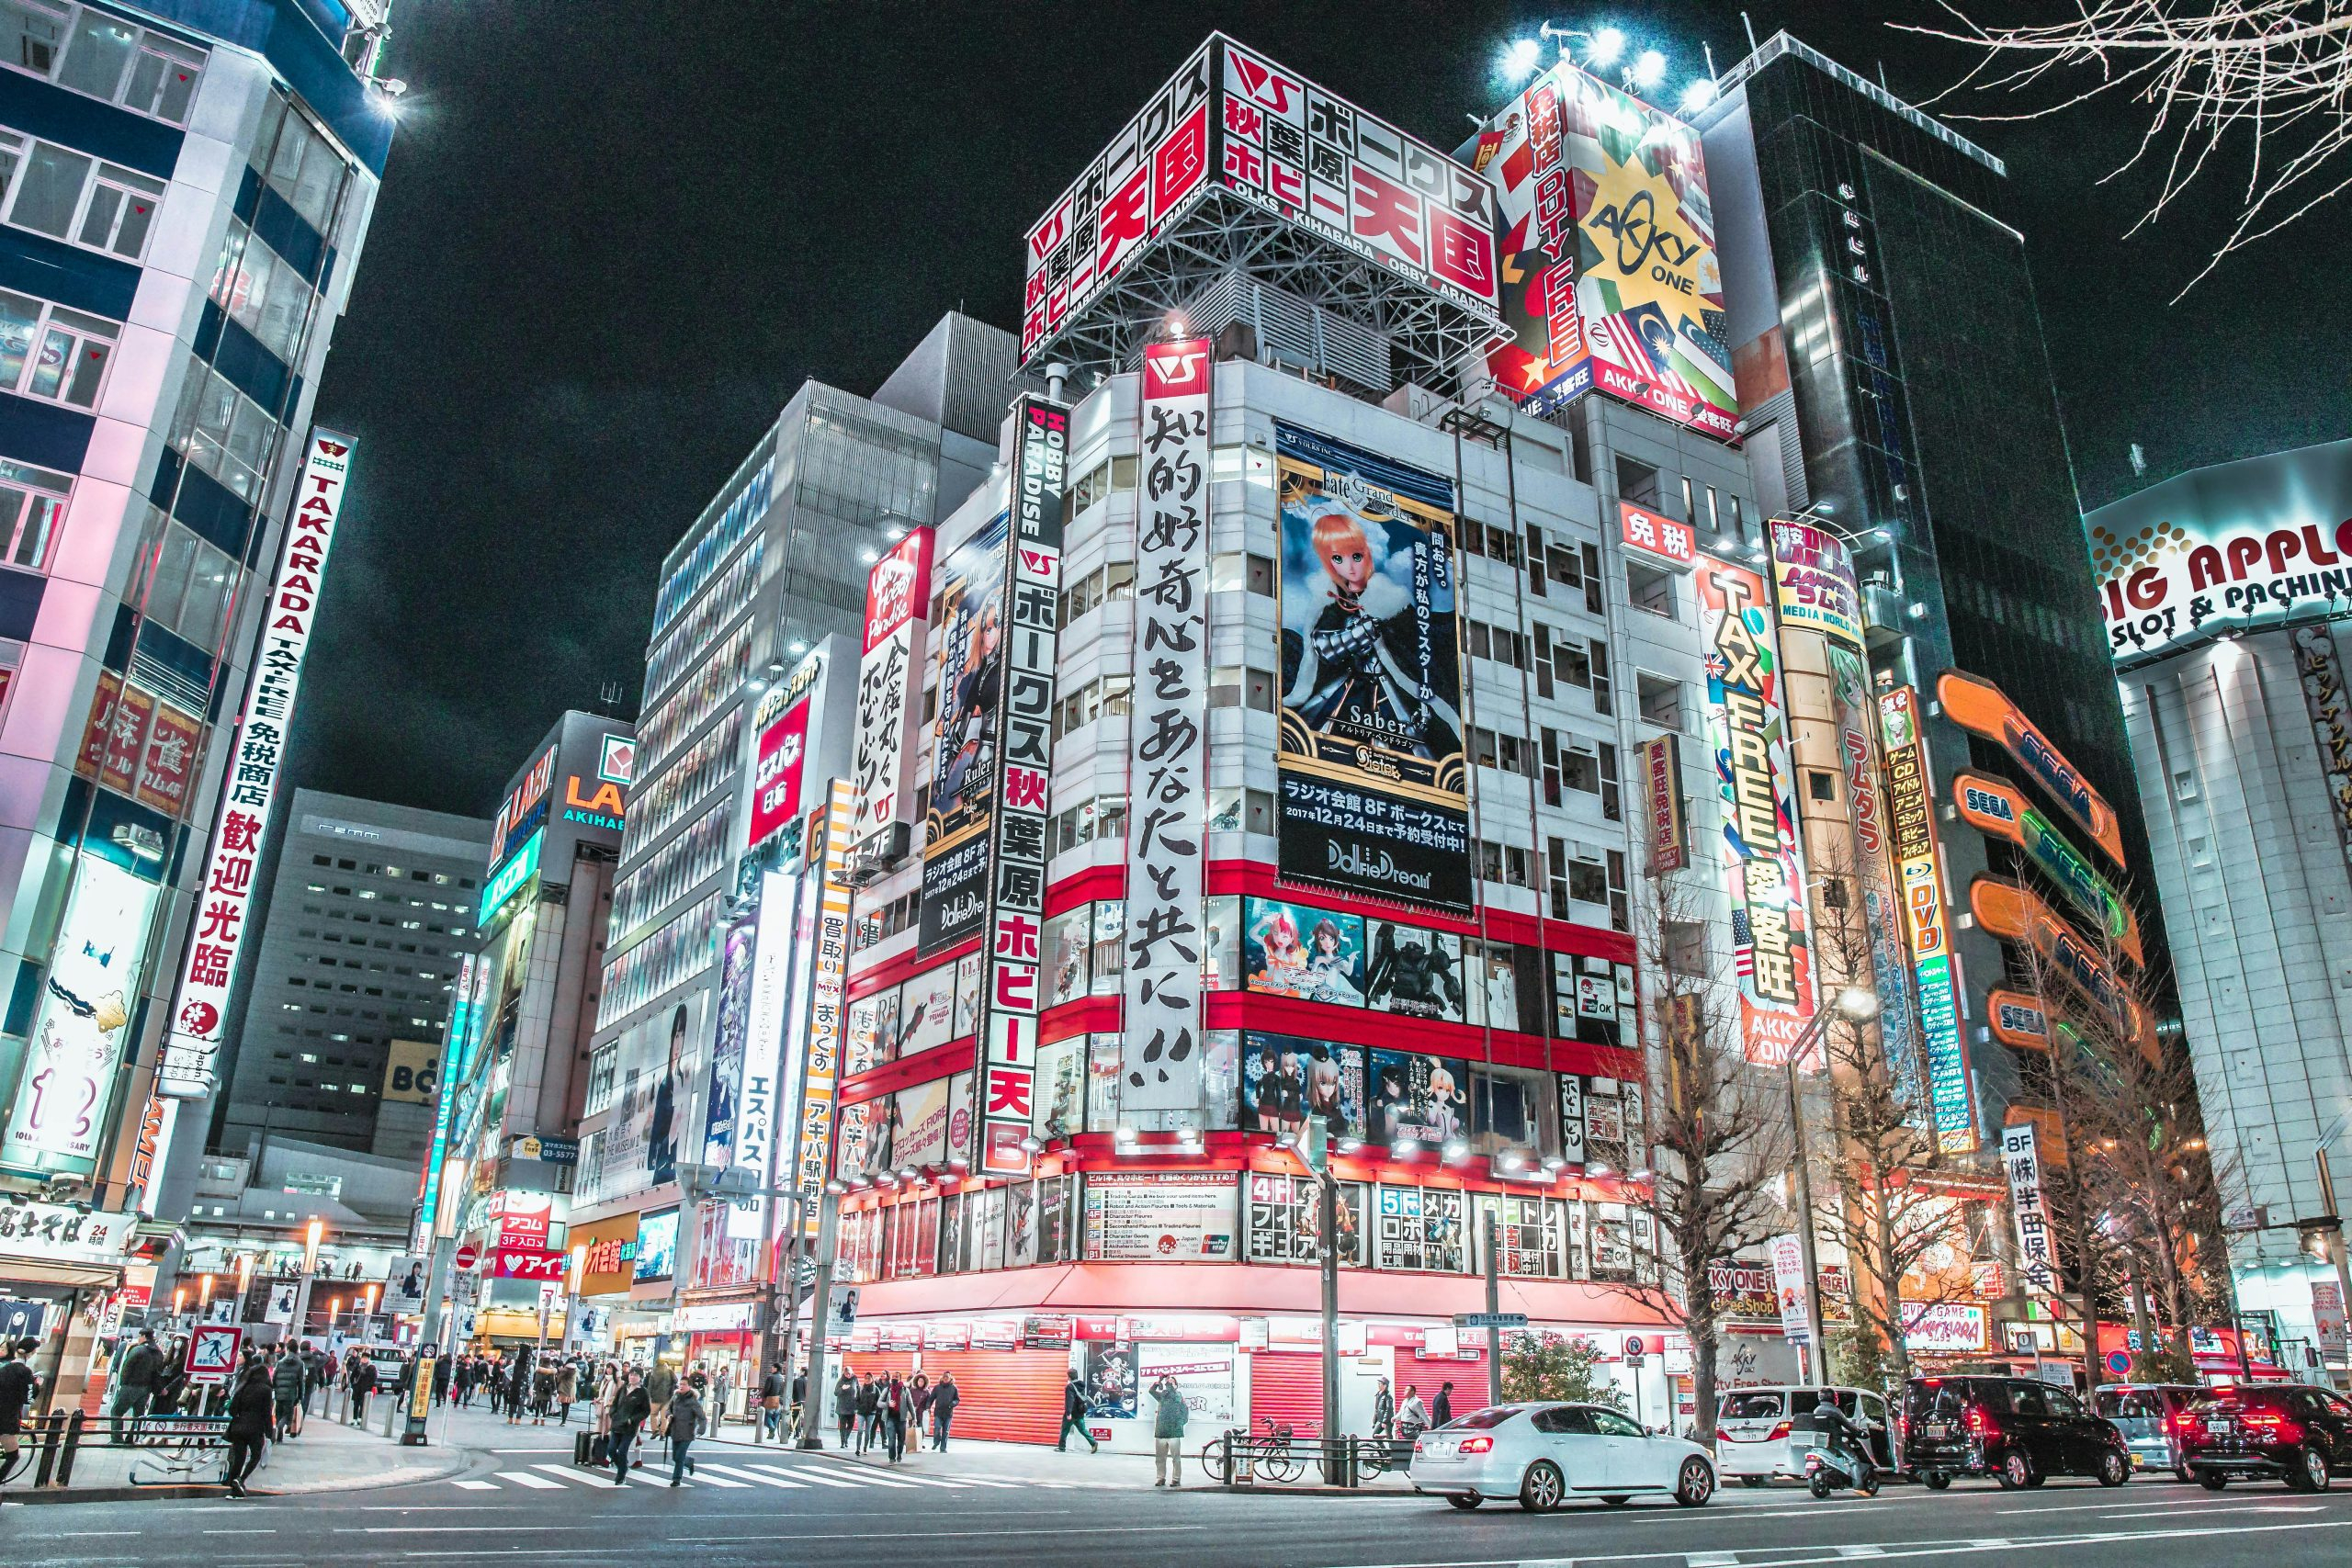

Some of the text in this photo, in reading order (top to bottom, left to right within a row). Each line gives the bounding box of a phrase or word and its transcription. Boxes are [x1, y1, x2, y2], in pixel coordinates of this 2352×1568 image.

[1075, 50, 1209, 222] ボークス
[1309, 98, 1490, 225] ボークス
[1054, 275, 1110, 340] AKIHABARA
[1112, 233, 1150, 277] HOBBY
[1152, 178, 1209, 239] PARADISE
[1225, 174, 1499, 320] VOLKS AKIHABARA HOBBY PARADISE
[1534, 170, 1581, 368] DUTY FREE
[1651, 265, 1695, 297] ONE
[1653, 389, 1688, 415] ONE
[1298, 439, 1321, 453] VOLKS
[1021, 406, 1066, 537] HOBBY PARADISE
[1322, 468, 1351, 500] Fate
[1353, 477, 1394, 503] Grand
[1368, 498, 1413, 524] Order
[1627, 512, 1690, 560] 免税
[271, 473, 338, 636] TAKARADA
[1782, 604, 1850, 631] MEDIA WORLD
[2112, 606, 2177, 648] SLOT
[2189, 595, 2216, 619] &
[1711, 572, 1781, 851] TAX FREE
[1881, 690, 1908, 716] 激安
[1350, 705, 1407, 736] Saber
[231, 721, 280, 807] 免税商店
[756, 732, 802, 790] エスパス
[1889, 746, 1917, 765] ゲーム
[964, 760, 993, 786] Ruler
[1894, 762, 1915, 781] CD
[508, 745, 555, 832] LABI
[1284, 781, 1362, 810] ラジオ会館
[1365, 797, 1386, 818] 8F
[1893, 779, 1921, 796] アイドル
[1894, 791, 1923, 812] アニメ
[1966, 787, 2015, 823] SEGA
[1897, 808, 1925, 828] コミック
[1901, 827, 1927, 844] ホビー
[1902, 840, 1929, 860] フィギュア
[924, 843, 975, 884] ラジオ会館 8F
[188, 808, 262, 988] 歓迎光臨
[1911, 883, 1942, 955] DVD
[819, 917, 845, 975] 買取り
[461, 964, 470, 983] LABI
[1599, 1003, 1611, 1014] OK
[741, 1076, 769, 1163] エスパス
[926, 1105, 946, 1130] FIORE
[2007, 1134, 2033, 1154] 8F
[1253, 1177, 1292, 1202] 4F
[1088, 1200, 1102, 1209] 5F
[1088, 1210, 1101, 1219] 4F
[1383, 1191, 1419, 1215] 5F
[1424, 1194, 1461, 1218] メカ
[88, 1224, 108, 1247] 24 時間
[506, 1216, 543, 1232] アコム
[1088, 1230, 1101, 1239] 2F
[502, 1235, 537, 1247] 3F 入口
[1614, 1251, 1628, 1262] OK
[1734, 1268, 1768, 1292] ONE
[1746, 1296, 1775, 1315] Shop
[1937, 1305, 1965, 1318] GAME
[1734, 1378, 1758, 1388] Free
